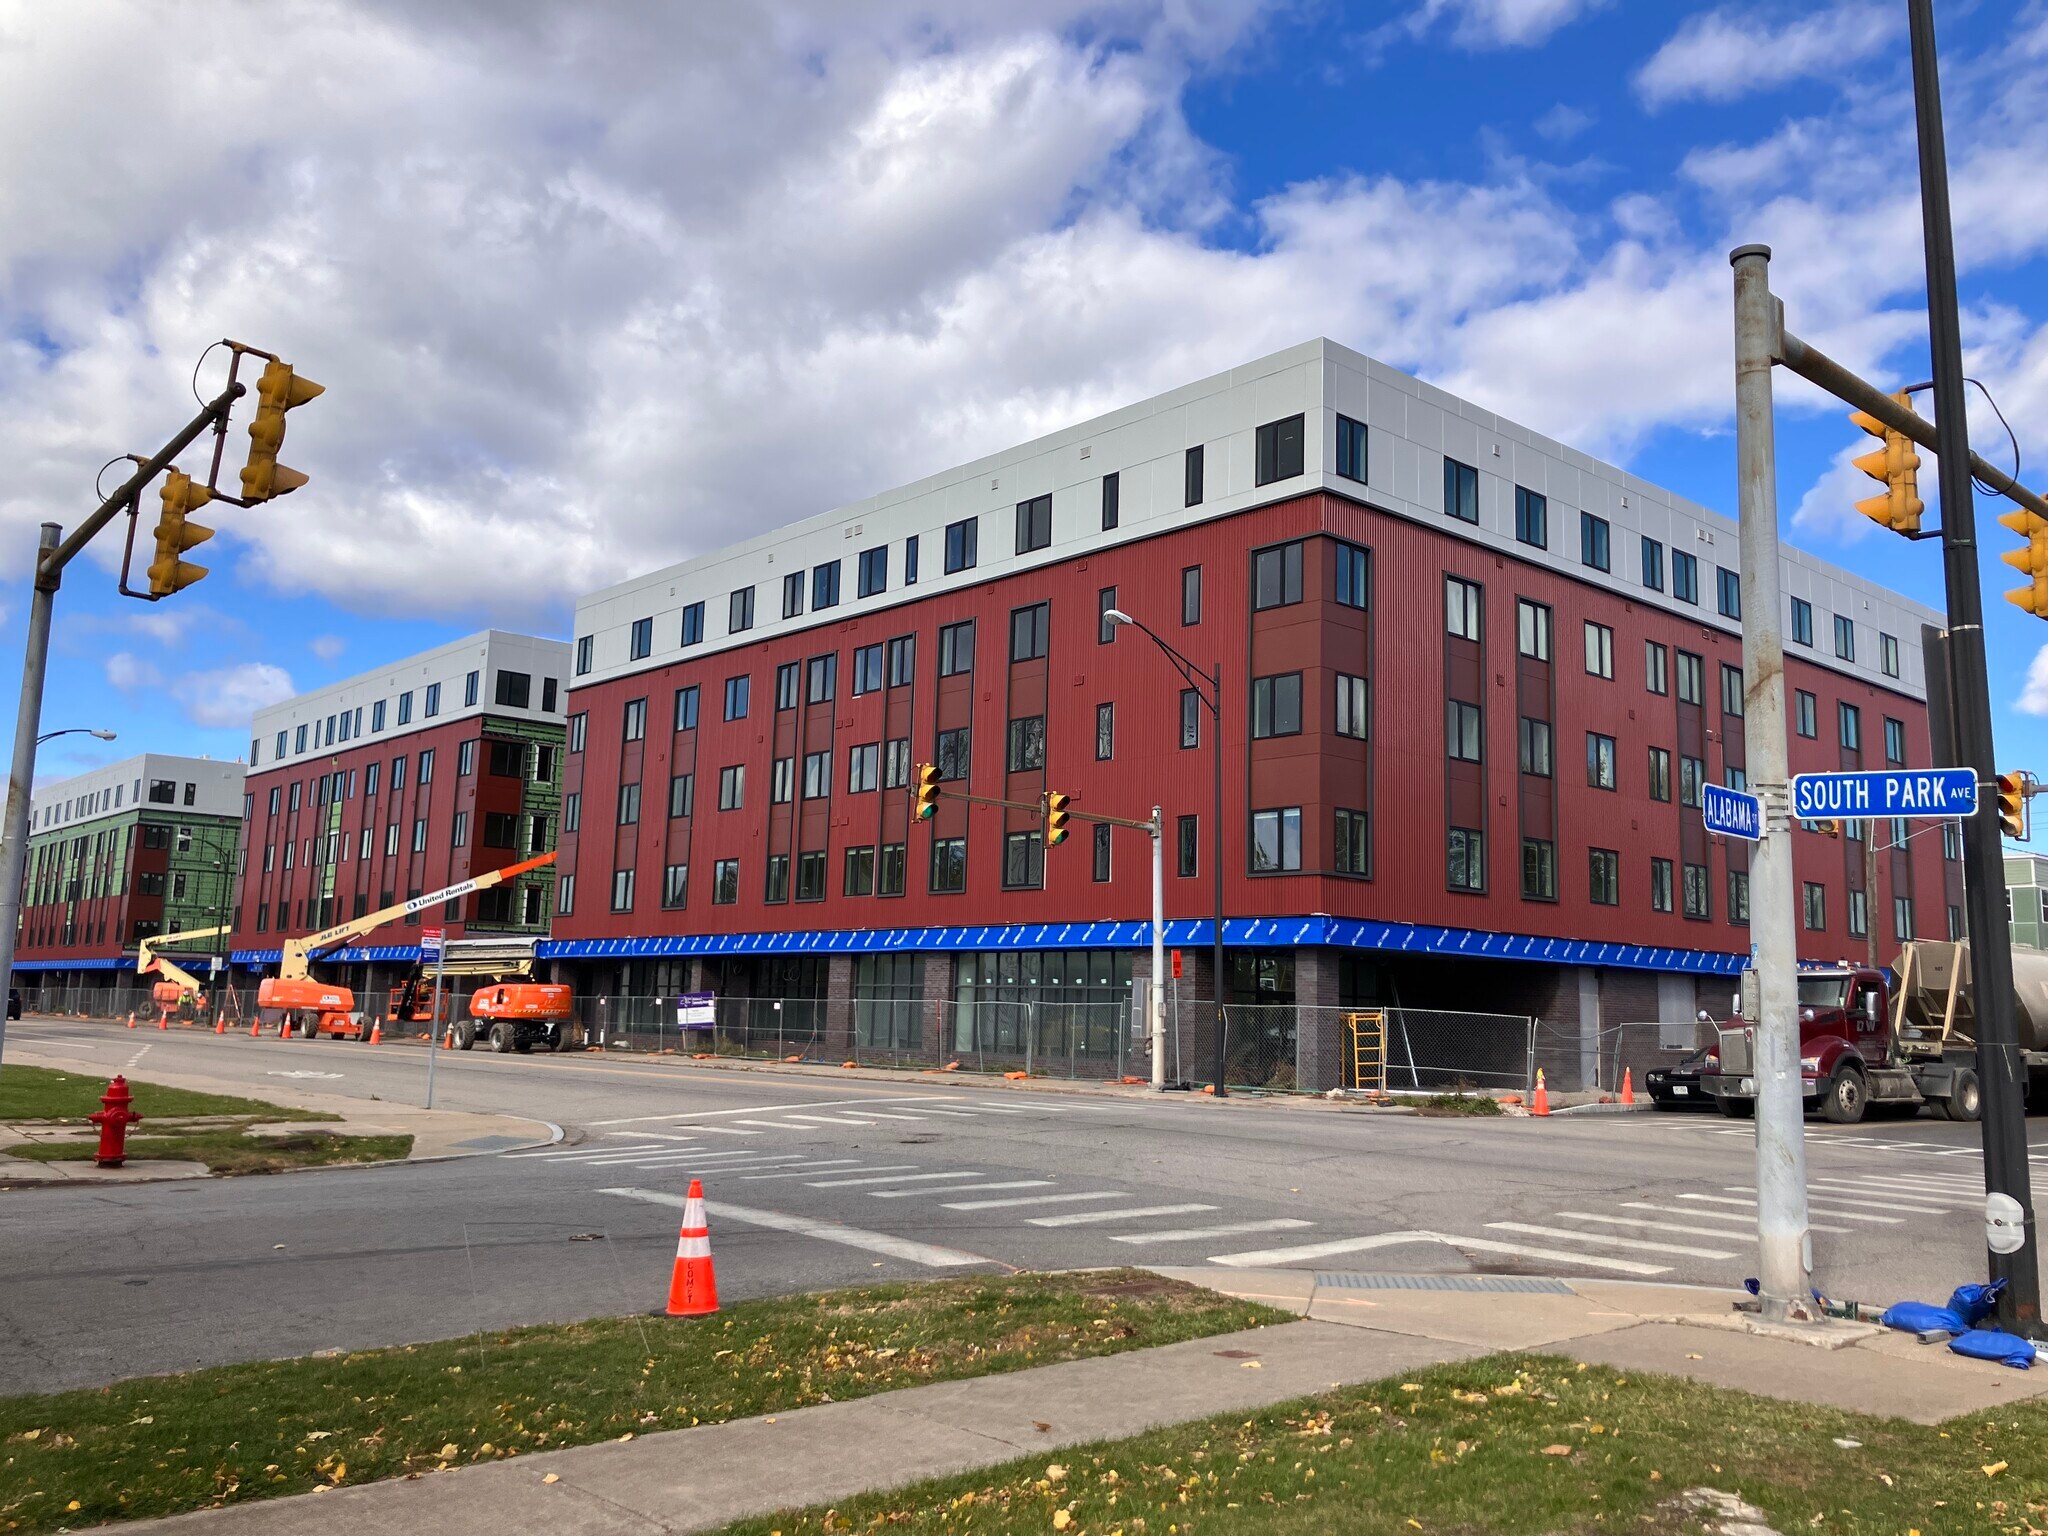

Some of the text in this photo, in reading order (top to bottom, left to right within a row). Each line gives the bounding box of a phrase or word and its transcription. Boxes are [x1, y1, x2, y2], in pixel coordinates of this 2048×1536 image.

[1800, 777, 1972, 810] SOUTH PARK AVE
[1707, 793, 1752, 832] ALABAMA
[418, 882, 474, 907] United Rentals
[319, 925, 351, 942] JLG LIFT
